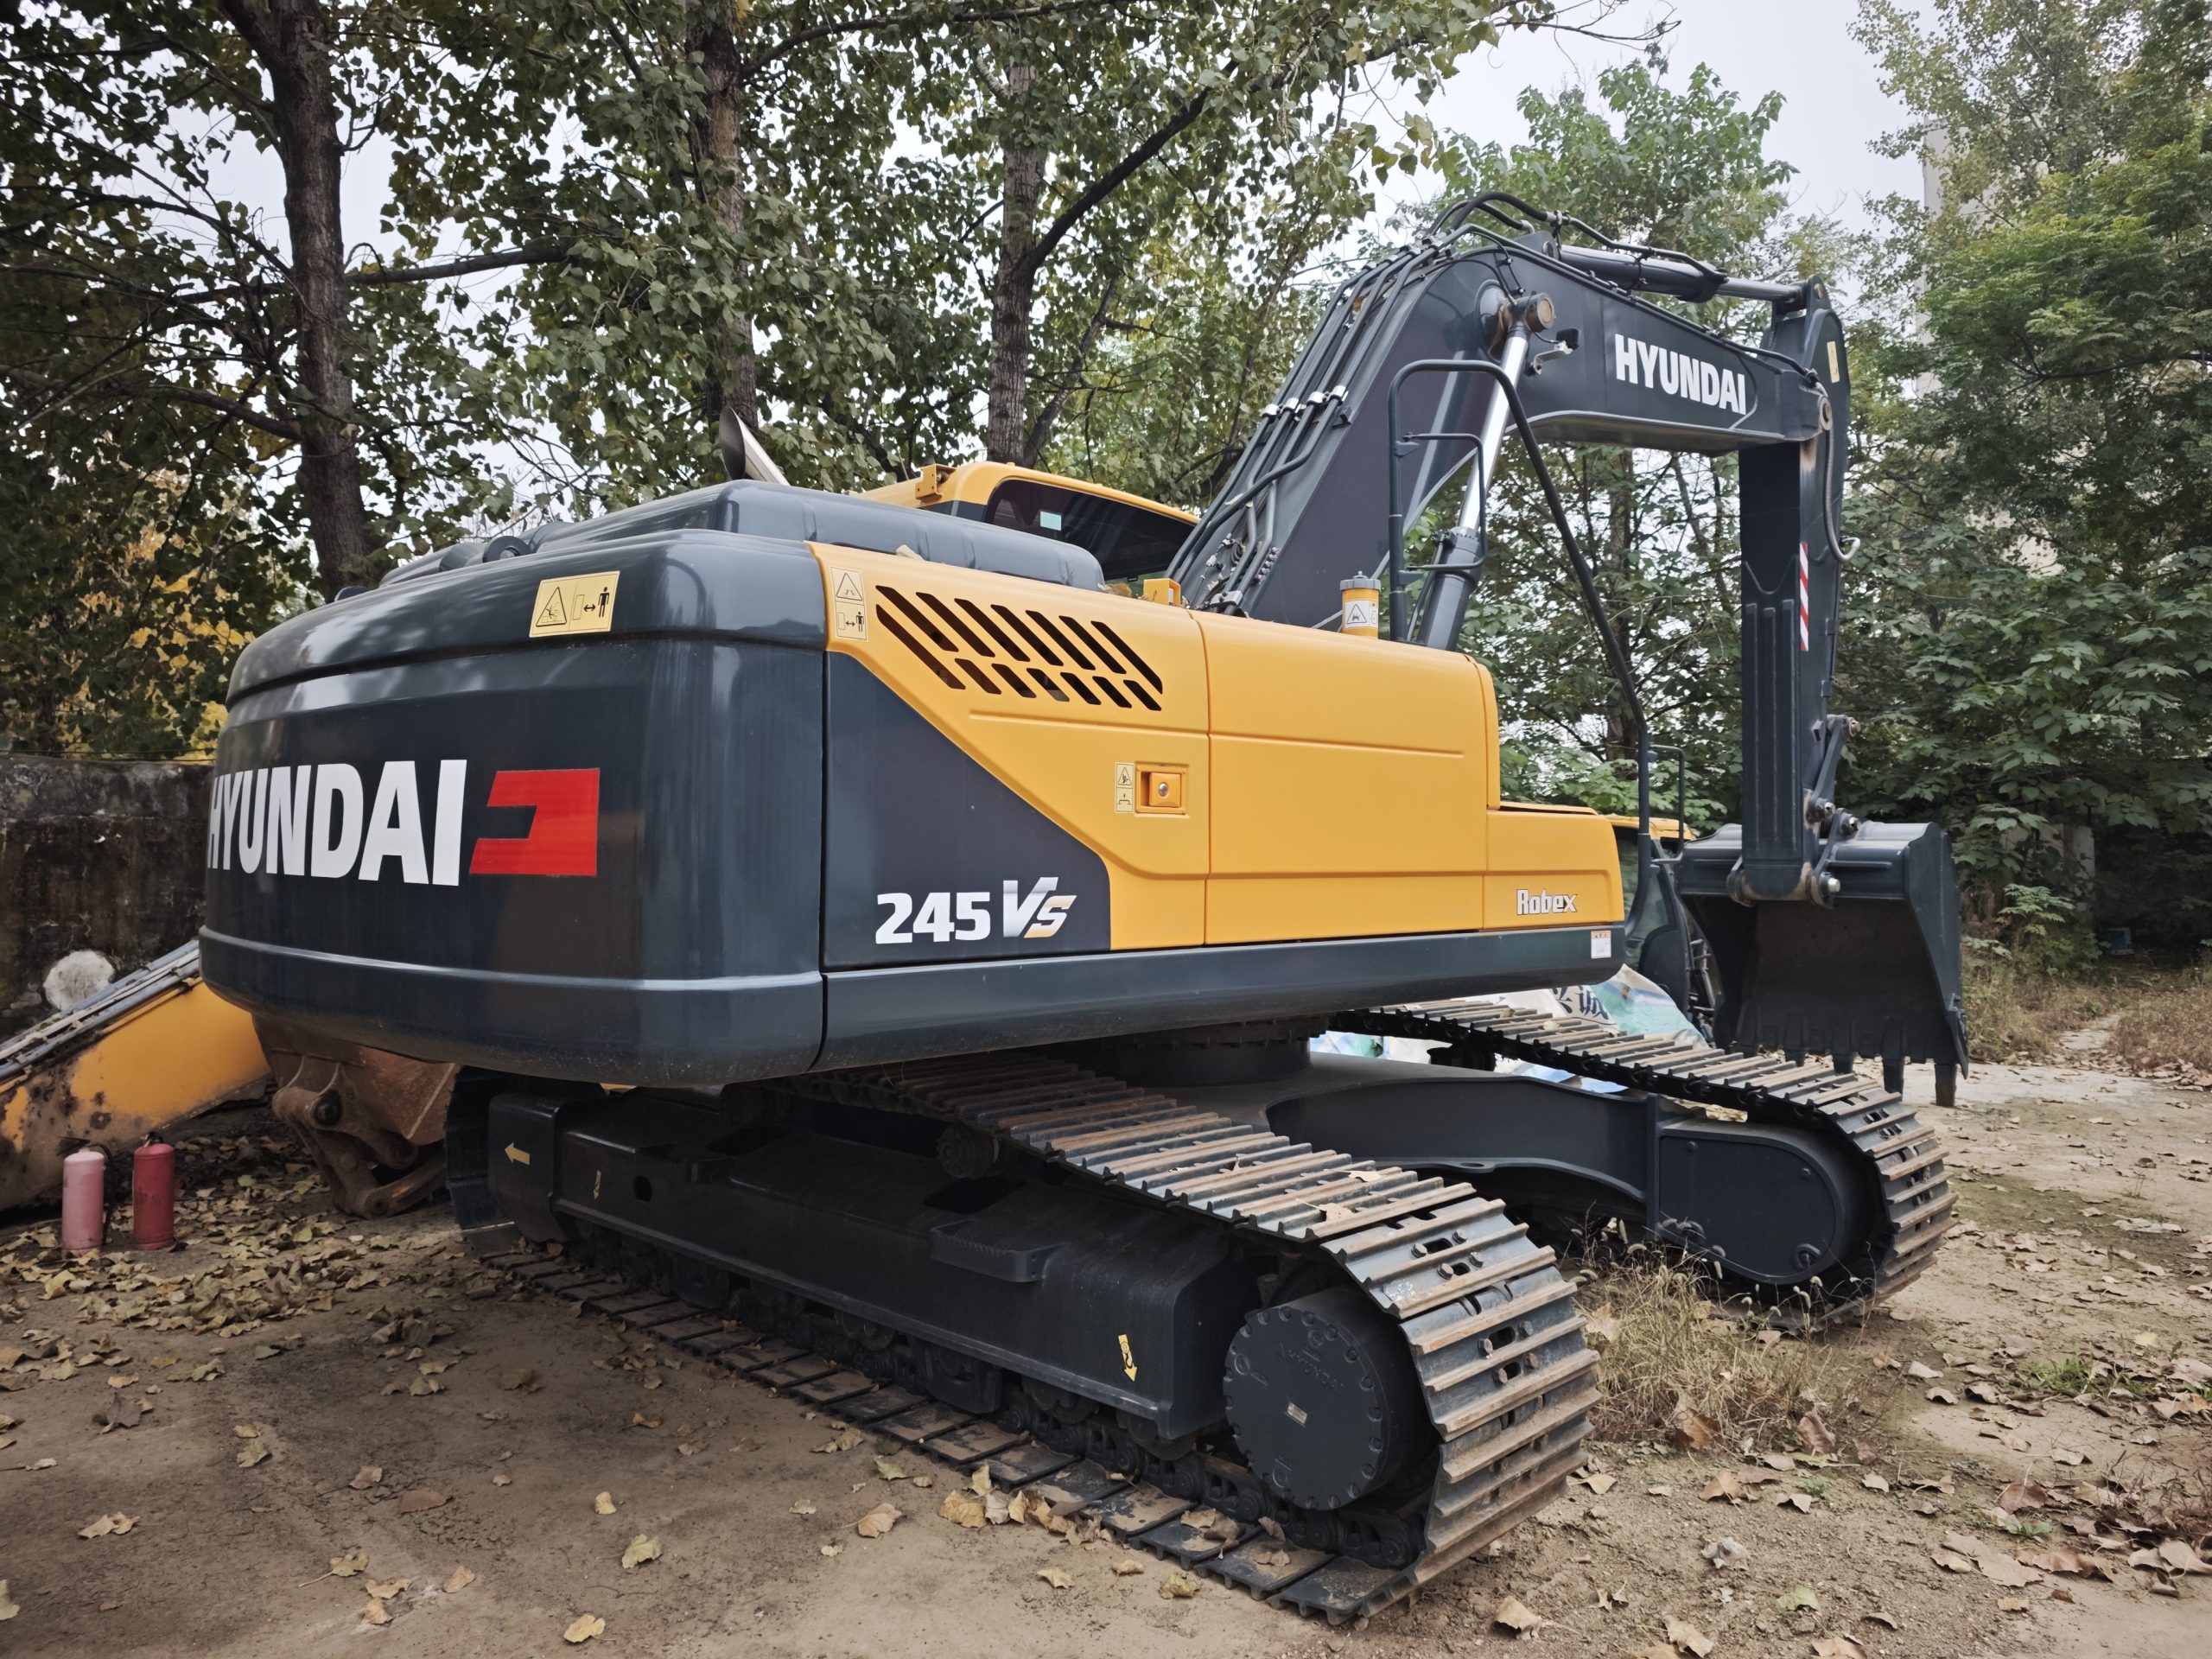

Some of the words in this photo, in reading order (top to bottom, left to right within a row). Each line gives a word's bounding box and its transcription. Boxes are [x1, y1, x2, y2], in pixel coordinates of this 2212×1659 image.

[1615, 334, 1746, 415] HYUNDAI
[207, 760, 467, 886] HYUNDAI
[875, 892, 991, 944] 245
[1516, 889, 1578, 915] Robex
